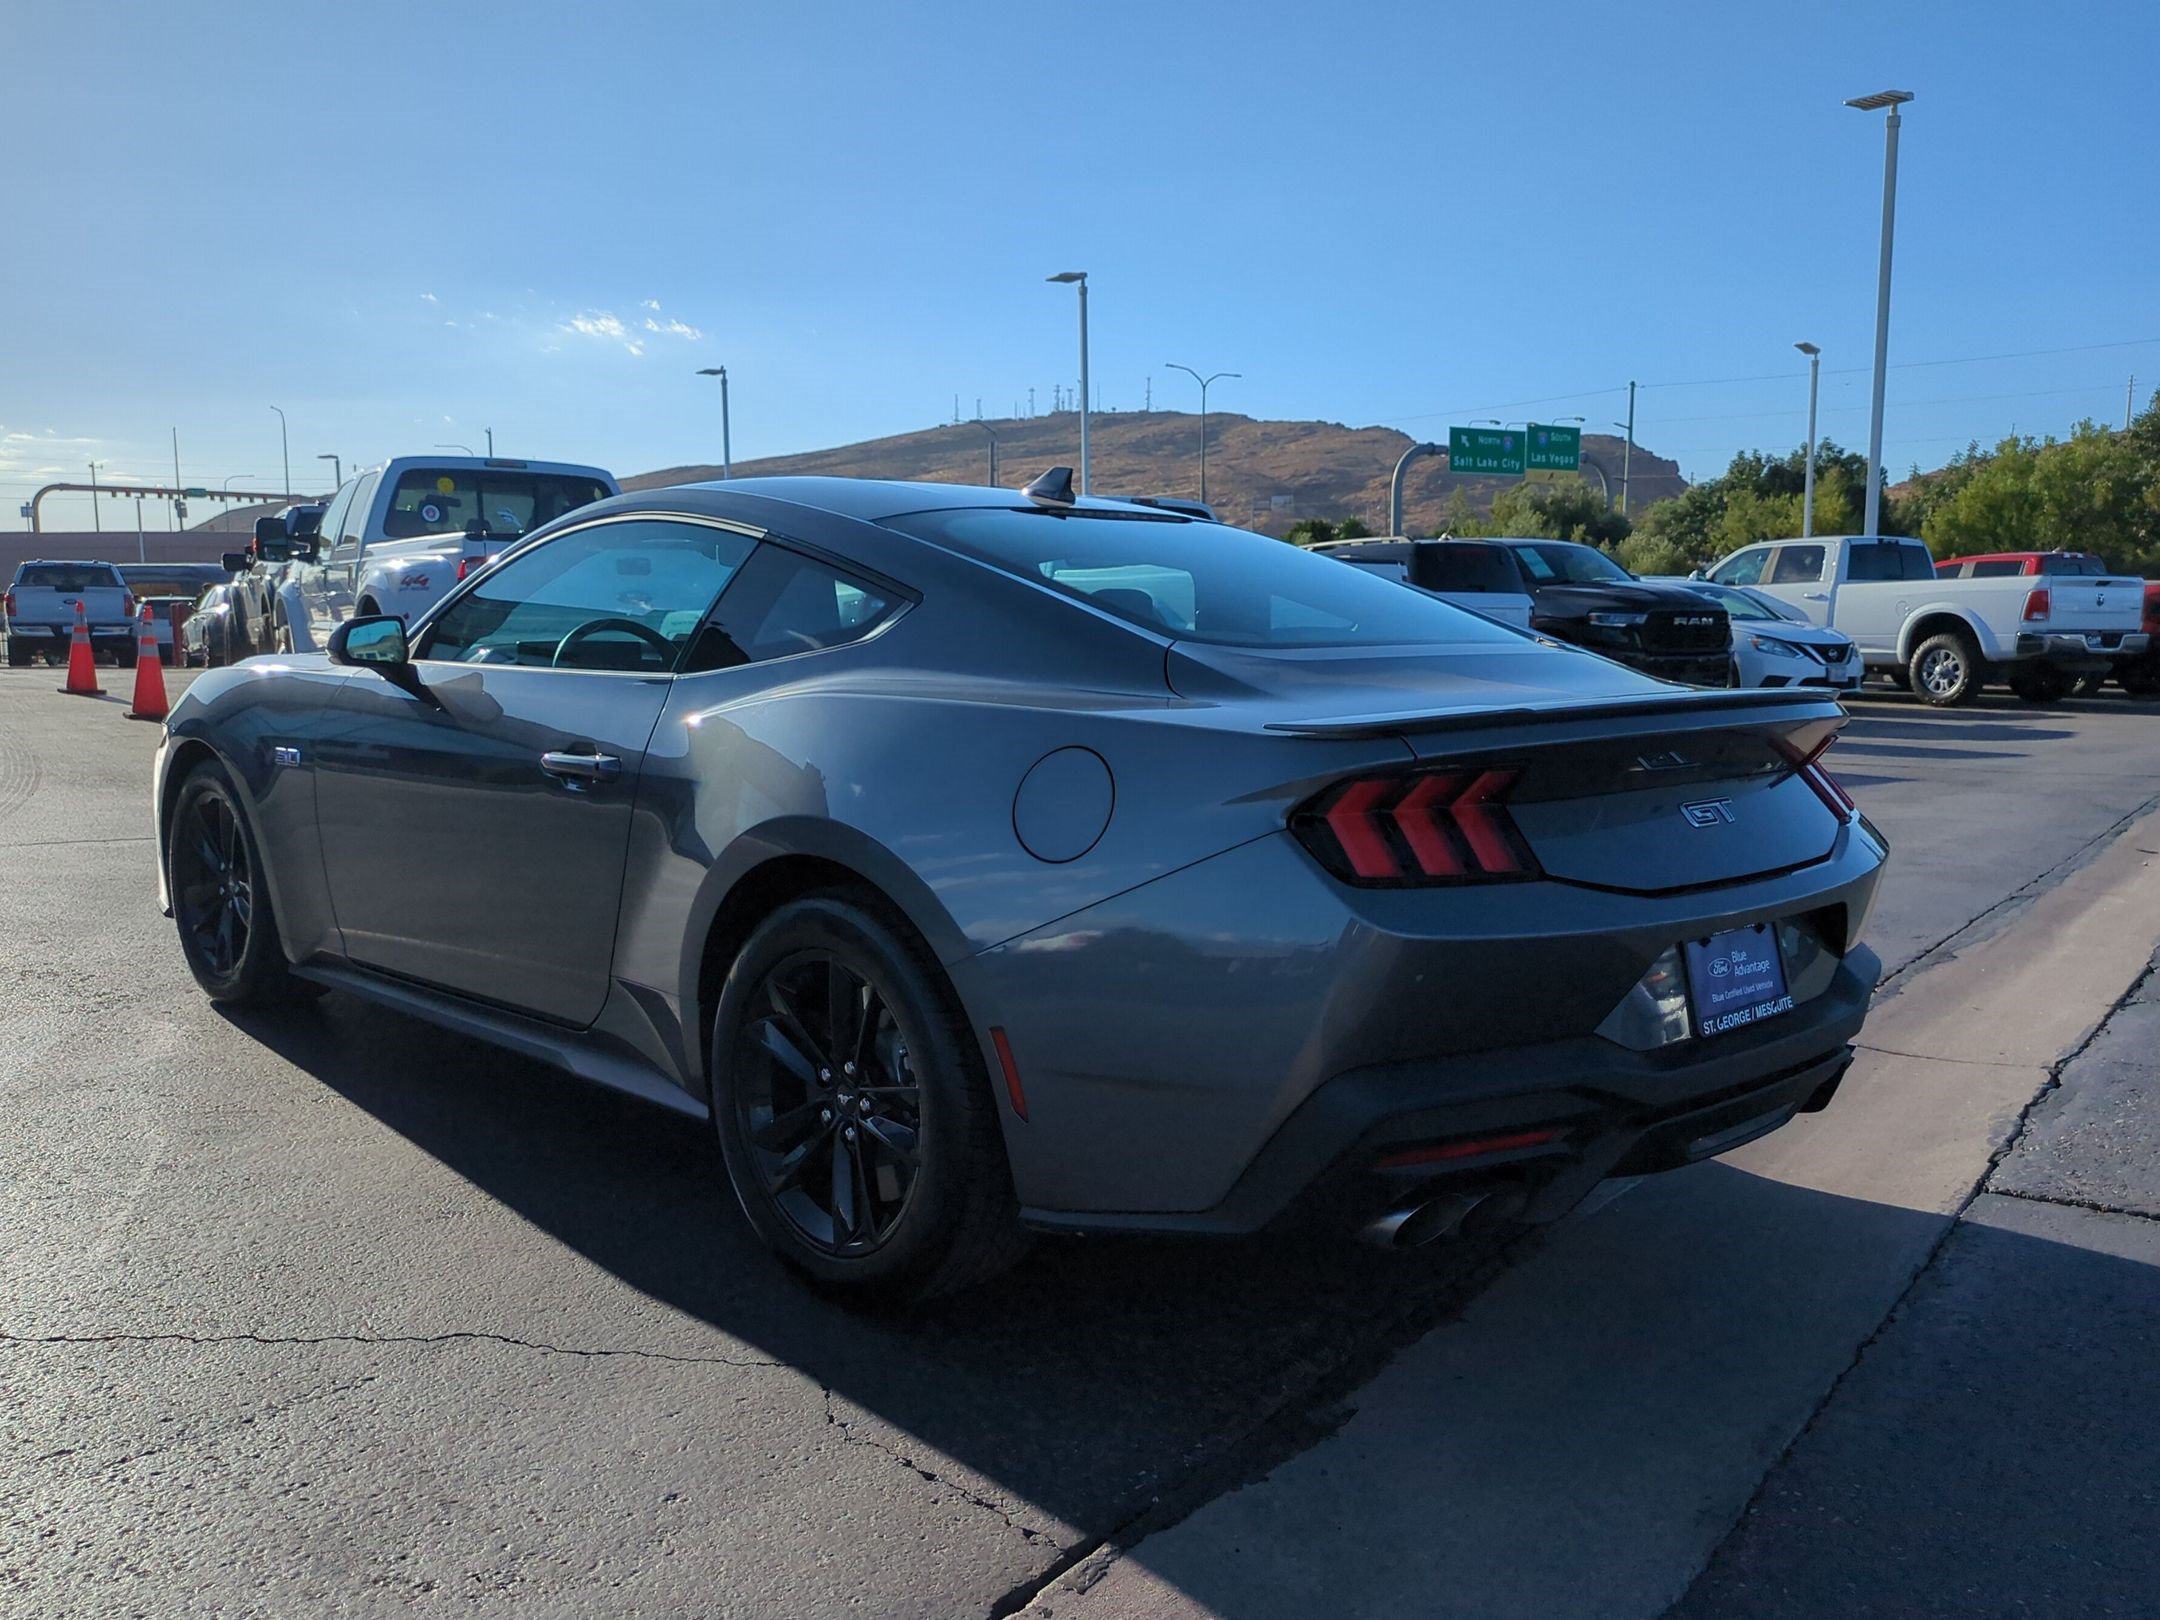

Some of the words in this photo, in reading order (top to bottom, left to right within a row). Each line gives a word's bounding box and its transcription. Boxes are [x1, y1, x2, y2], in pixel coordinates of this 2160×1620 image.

[1453, 455, 1473, 468] Salt
[1476, 456, 1498, 468] Lake
[1502, 458, 1521, 471] City
[1531, 452, 1546, 463] Las
[1549, 453, 1575, 466] Vegas
[1673, 616, 1714, 626] RAM
[1680, 796, 1736, 828] GT
[1731, 950, 1747, 963] Blue
[1711, 960, 1730, 976] Ford
[1734, 960, 1771, 977] Advantage
[1703, 1019, 1717, 1035] ST.
[1716, 1008, 1751, 1031] GEORGE
[1755, 995, 1793, 1019] MESQUITE
